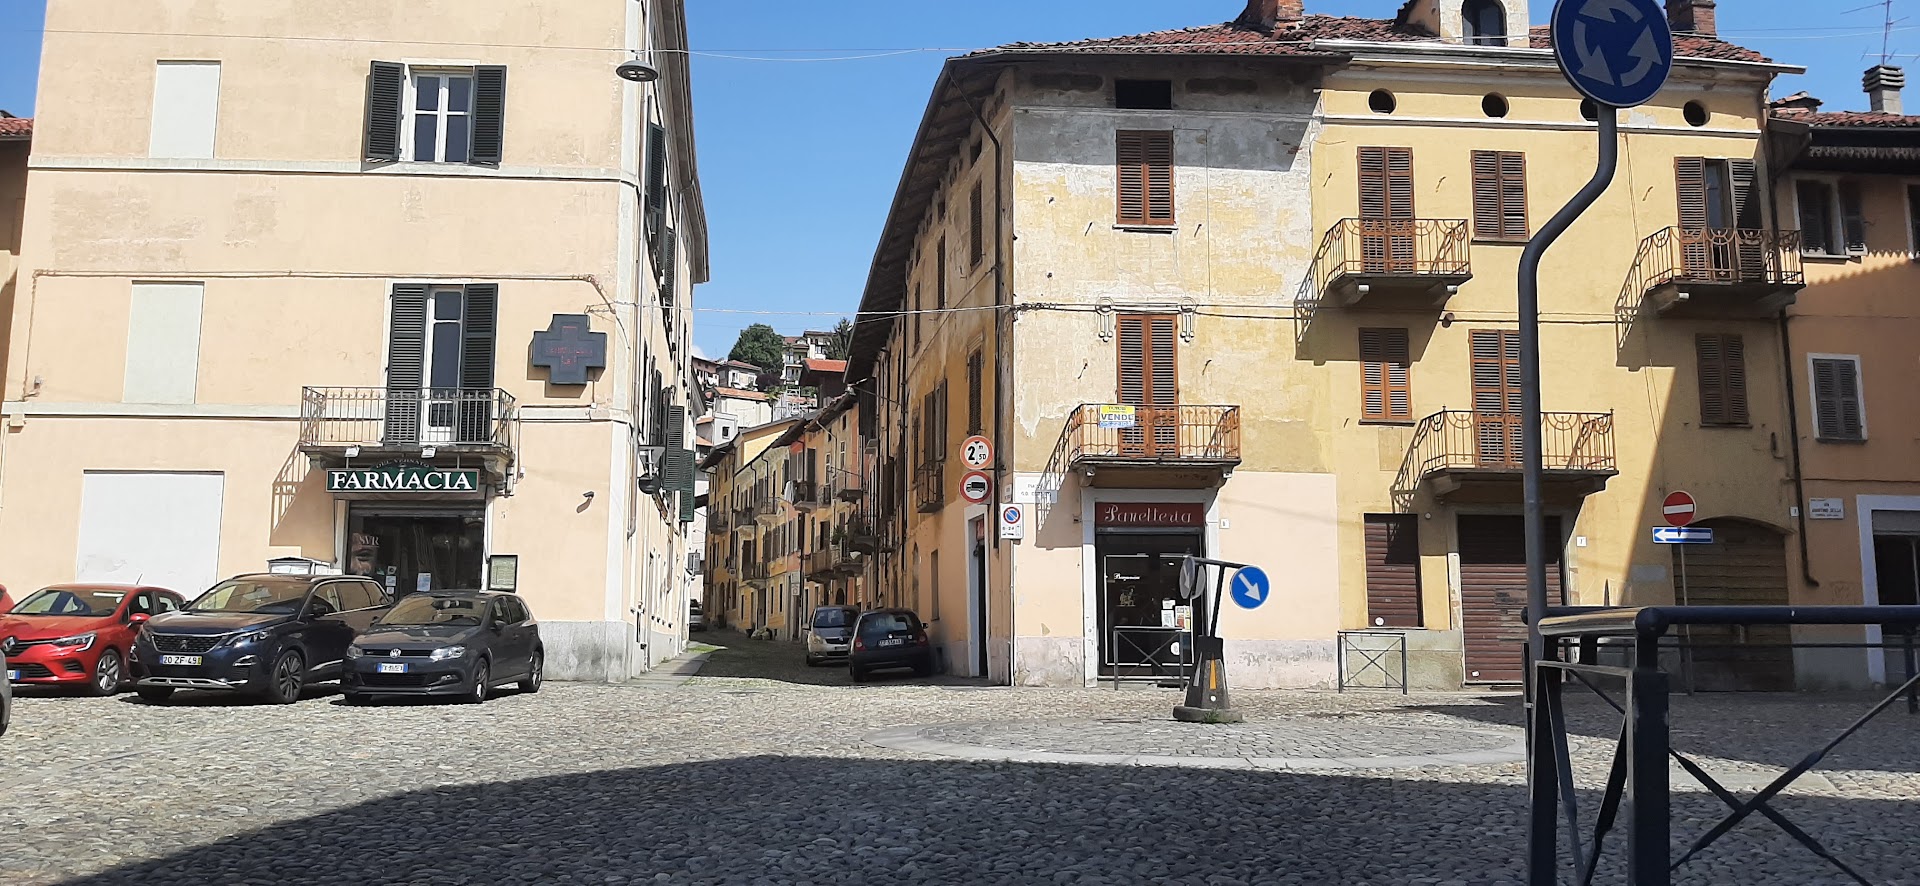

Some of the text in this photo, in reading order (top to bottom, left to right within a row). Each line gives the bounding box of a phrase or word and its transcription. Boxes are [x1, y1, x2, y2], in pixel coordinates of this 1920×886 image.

[1101, 413, 1135, 421] VENDE
[967, 446, 976, 461] 2
[331, 471, 473, 490] FARMACIA
[1104, 504, 1192, 523] Panetteria
[359, 536, 380, 546] SVR
[163, 656, 173, 664] 20
[174, 656, 186, 664] ZF
